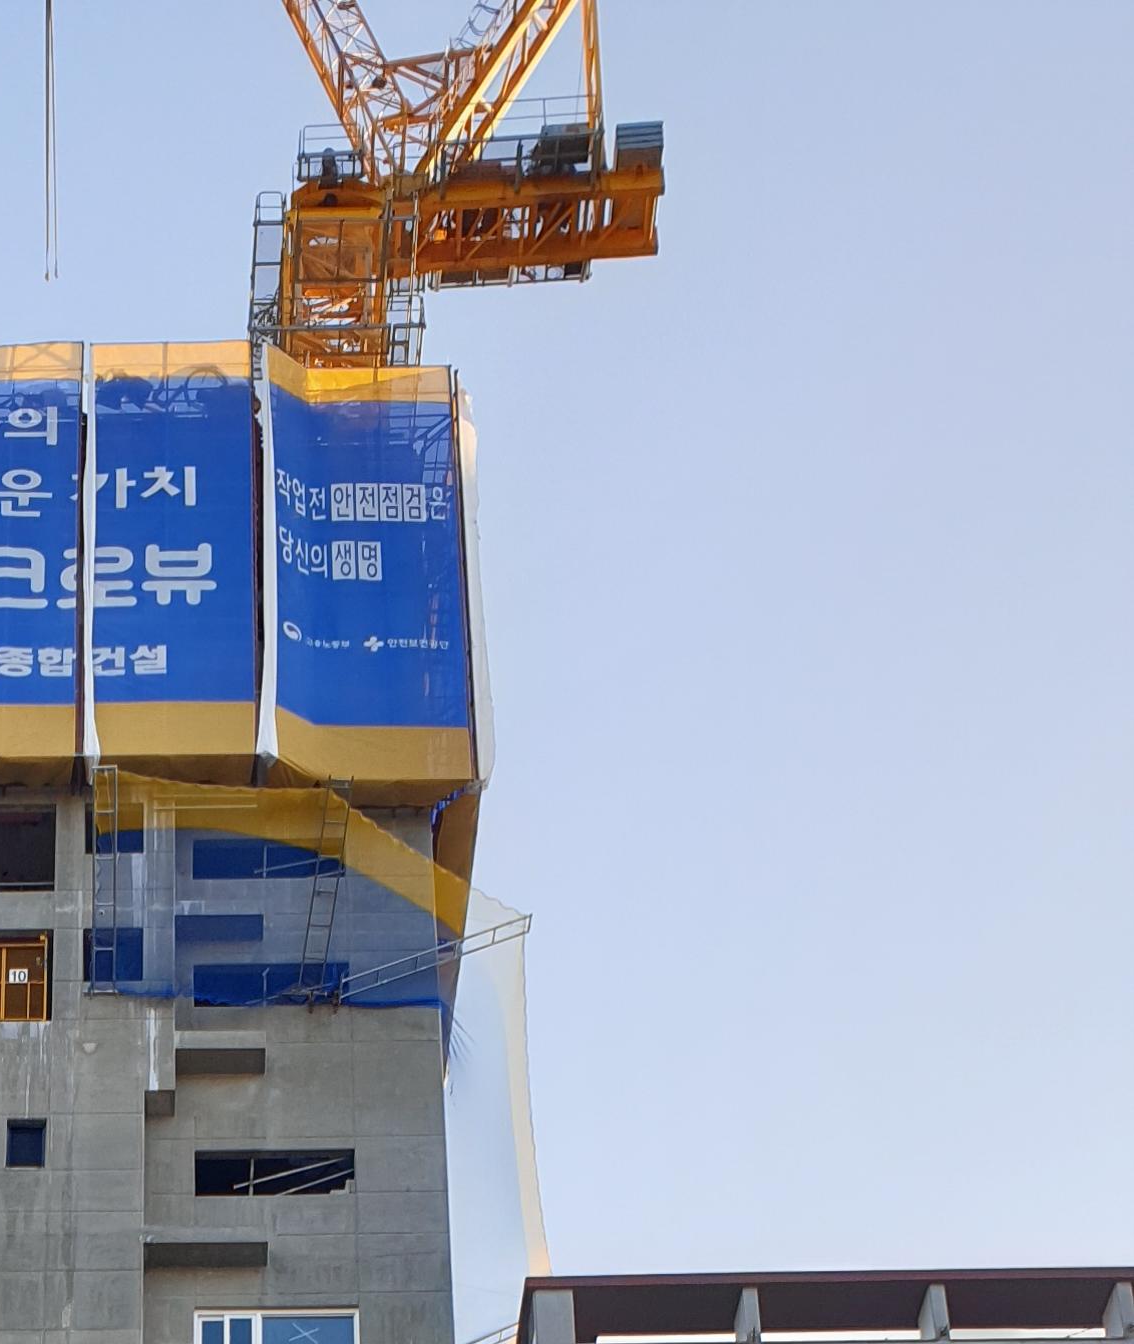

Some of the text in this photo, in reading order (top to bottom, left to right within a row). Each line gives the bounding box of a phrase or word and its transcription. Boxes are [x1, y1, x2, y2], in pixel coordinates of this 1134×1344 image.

[70, 466, 197, 508] 가치
[278, 525, 382, 580] 당신의 생명
[11, 969, 27, 983] 10
